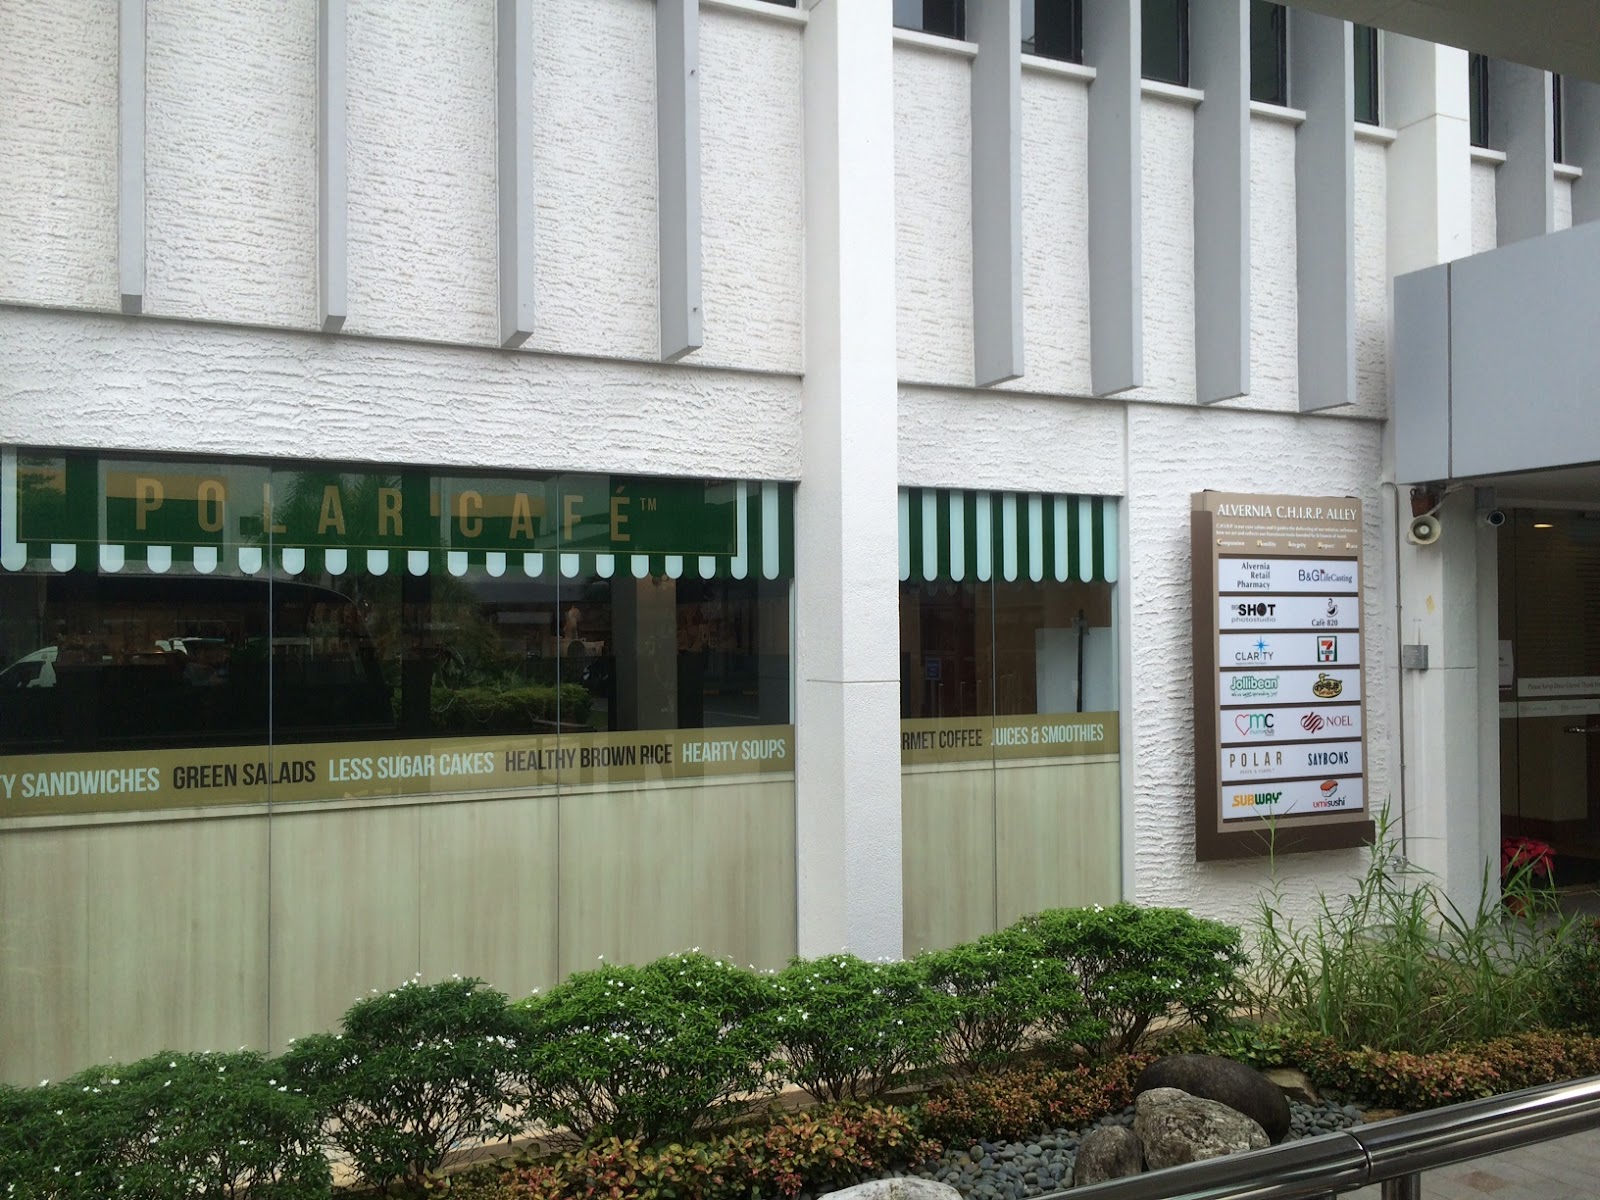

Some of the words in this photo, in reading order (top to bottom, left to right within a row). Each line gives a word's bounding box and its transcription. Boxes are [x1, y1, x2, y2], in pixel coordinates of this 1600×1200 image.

[135, 477, 404, 536] POLAR
[458, 485, 632, 542] CAFÉ
[1217, 503, 1272, 517] ALVERNIA
[1276, 505, 1323, 519] C.H.I.R.P.
[1326, 508, 1357, 521] ALLEY
[1241, 562, 1270, 570] Alvernia
[1250, 571, 1271, 579] Retail
[1236, 580, 1271, 590] Pharmacy
[1327, 618, 1339, 627] 820
[1230, 675, 1278, 691] Jollibean
[1326, 715, 1353, 727] NOEL
[938, 728, 983, 749] COFFEE
[1031, 726, 1039, 745] &
[1041, 723, 1104, 744] SMOOTHIES
[505, 748, 576, 772] HEALTHY
[580, 745, 637, 769] BROWN
[639, 743, 673, 767] RICE
[682, 741, 738, 764] HEARTY
[741, 738, 786, 761] SOUPS
[1229, 751, 1283, 768] POLAR
[1308, 751, 1349, 766] SAYBONS
[328, 757, 373, 781] LESS
[377, 753, 435, 779] SUGAR
[439, 751, 495, 777] CAKES
[21, 767, 160, 798] SANDWICHES
[173, 764, 237, 790] GREEN
[242, 760, 316, 786] SALADS
[1231, 791, 1283, 808] SUBWAY
